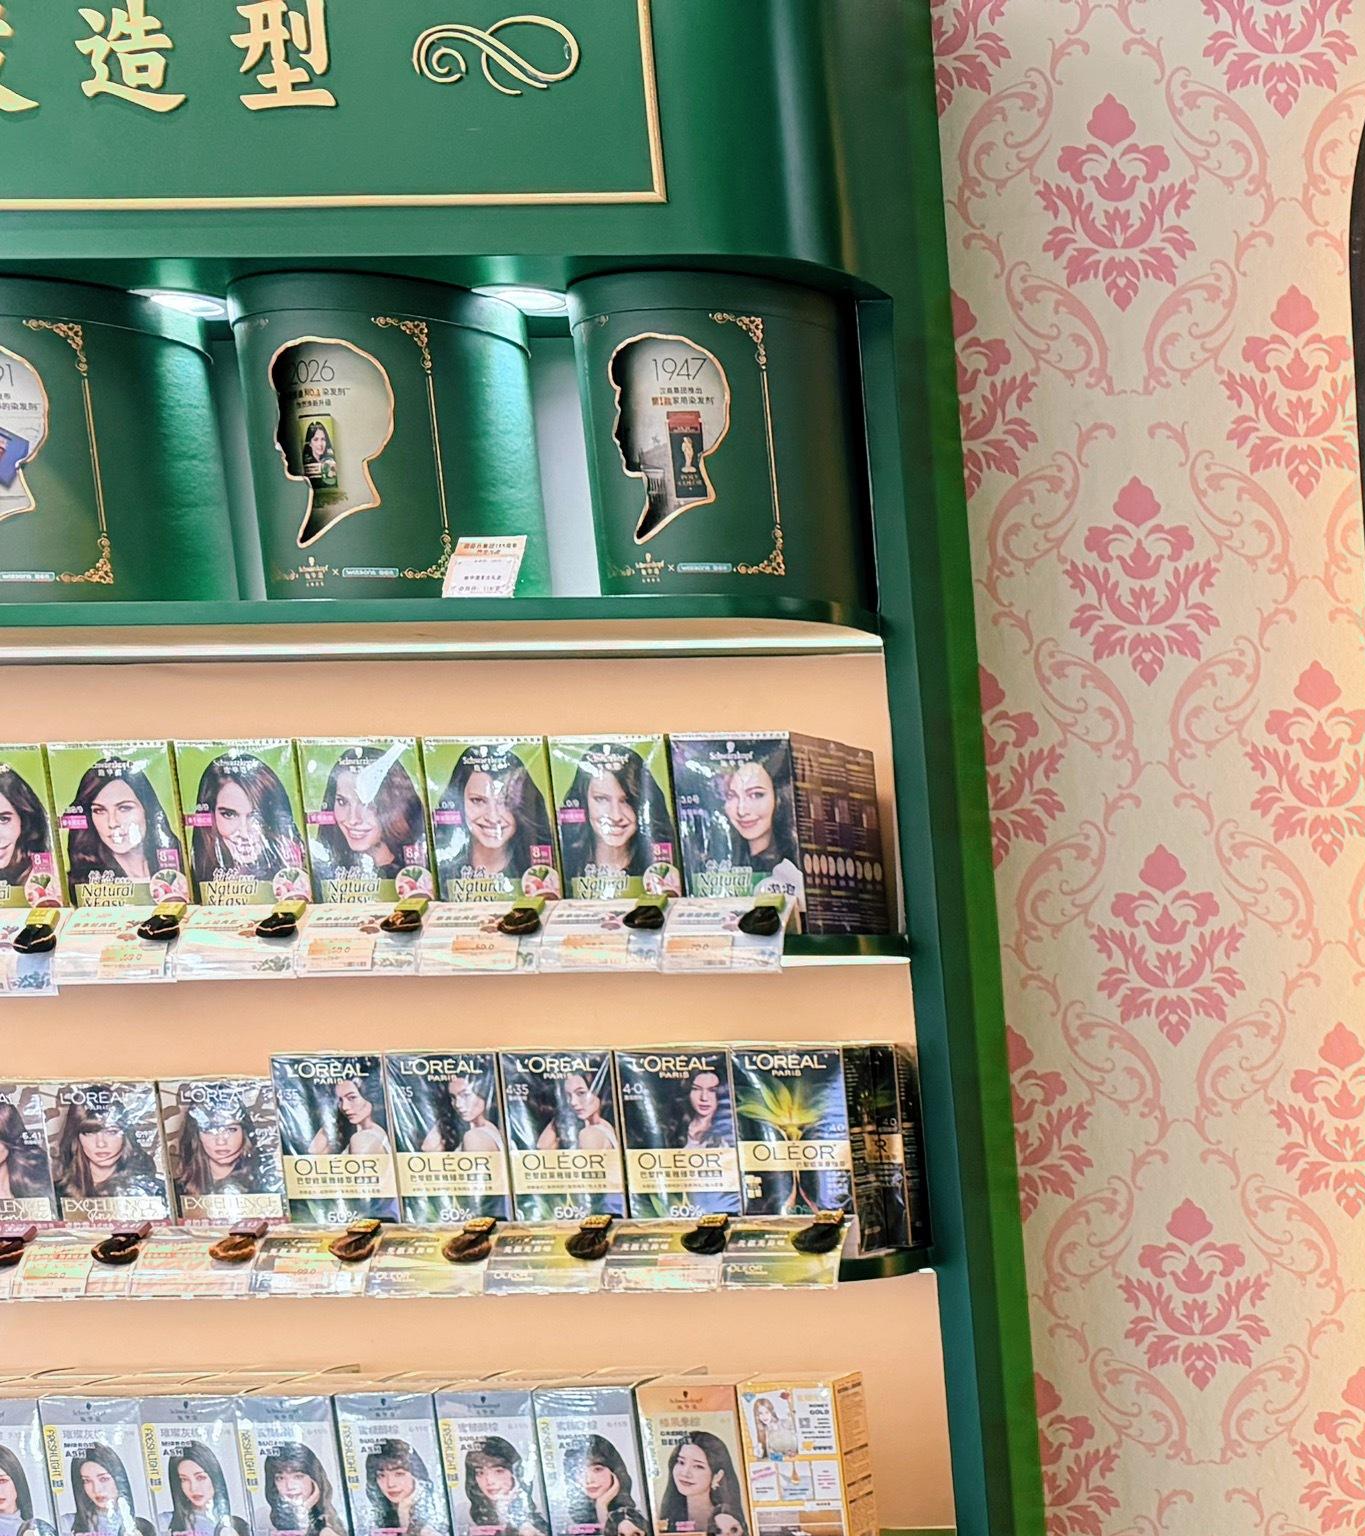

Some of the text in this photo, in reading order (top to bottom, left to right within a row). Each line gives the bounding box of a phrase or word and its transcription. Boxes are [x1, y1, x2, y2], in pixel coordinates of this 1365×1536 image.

[652, 358, 707, 383] 1947
[328, 880, 381, 895] Natural
[453, 879, 507, 894] Natura
[700, 873, 752, 889] Natural
[81, 881, 135, 898] Natural
[206, 881, 257, 897] Natural
[637, 1151, 722, 1169] OLÉOR
[753, 1143, 836, 1162] OLÉOR
[294, 1157, 380, 1175] OLÉOR
[407, 1154, 493, 1172] OLÉOR
[522, 1152, 607, 1170] OLÉOR
[327, 1210, 361, 1224] 60%
[440, 1208, 473, 1222] 60%
[554, 1205, 588, 1219] 60%
[670, 1204, 704, 1218] 60%
[65, 1450, 86, 1459] ASH
[162, 1448, 184, 1457] ASH
[259, 1447, 281, 1456] ASH
[360, 1445, 383, 1455] ASH
